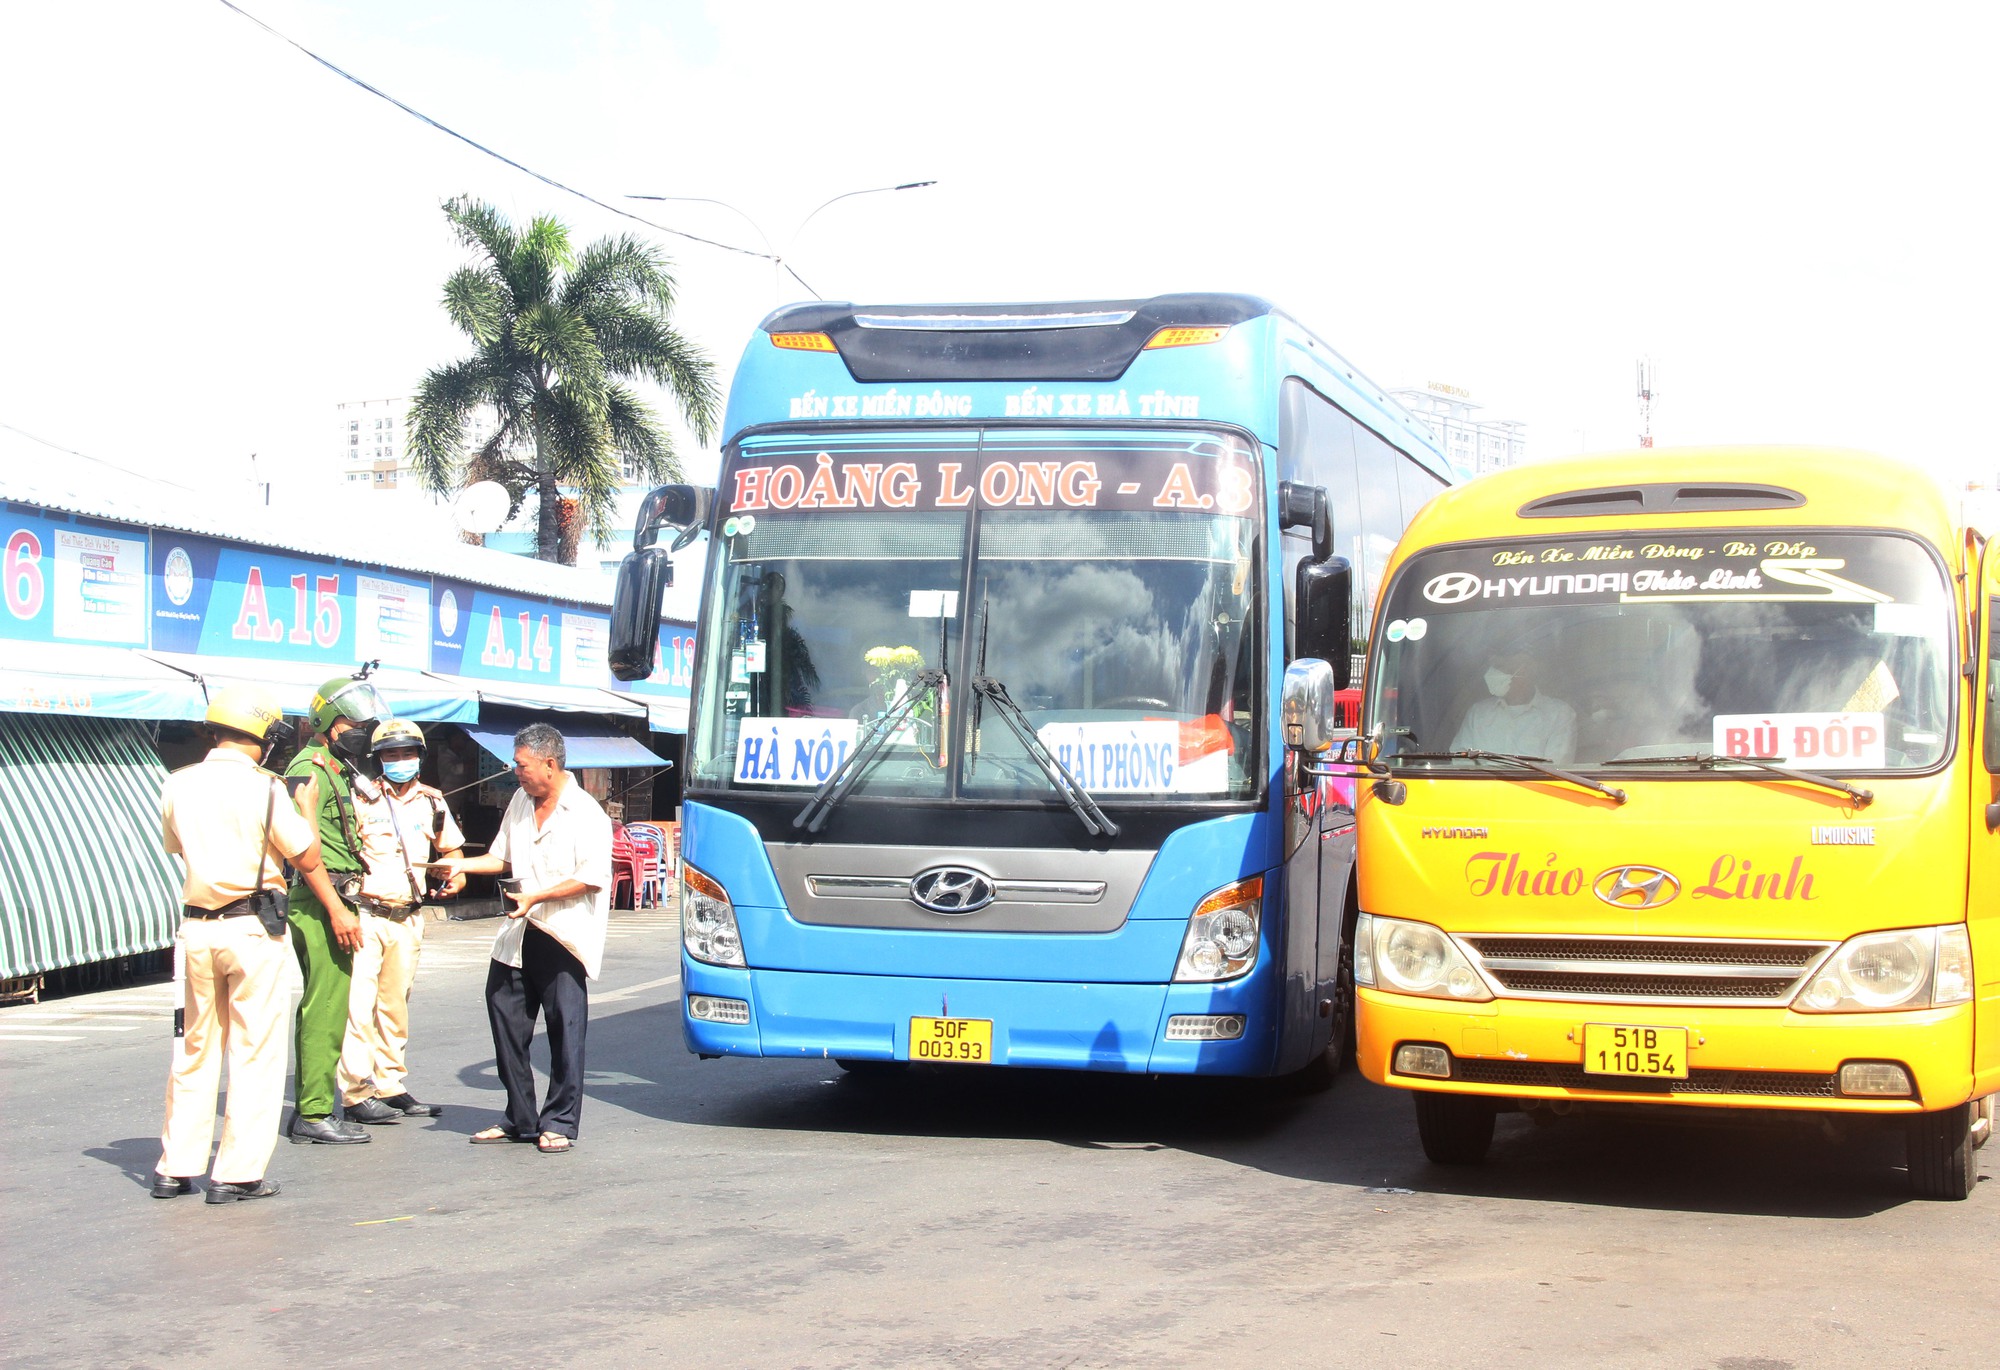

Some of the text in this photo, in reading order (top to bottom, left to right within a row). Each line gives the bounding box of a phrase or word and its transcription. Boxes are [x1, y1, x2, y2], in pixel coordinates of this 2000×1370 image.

[789, 389, 829, 418] BẾN
[831, 395, 859, 417] XE
[914, 389, 972, 417] ĐÔNG
[1004, 386, 1054, 417] BẾN
[1058, 394, 1091, 416] XE
[730, 451, 921, 513] HOÀNG
[935, 461, 1101, 507] LONG
[1492, 551, 1535, 566] Bến
[1540, 548, 1574, 563] Xe
[1577, 544, 1635, 561] Miền
[1640, 544, 1704, 560] Đông
[1722, 541, 1757, 557] Bù
[1763, 541, 1817, 559] Đốp
[1483, 572, 1629, 598] HYUNDAI
[1700, 568, 1763, 590] Linh
[232, 565, 342, 649] A.15
[481, 605, 553, 673] A.14
[1726, 716, 1877, 758] BÙ ĐỐP
[740, 726, 780, 780] HÀ
[1058, 726, 1173, 789] HẢI PHÒNG
[1421, 827, 1488, 839] HYUNDAI
[1811, 826, 1876, 846] LIMOUSINE
[1465, 851, 1820, 900] Thảo Linh
[934, 1021, 968, 1038] 50F
[1614, 1028, 1657, 1049] 51B
[919, 1040, 982, 1059] 003.93
[1599, 1051, 1675, 1074] 110.54
